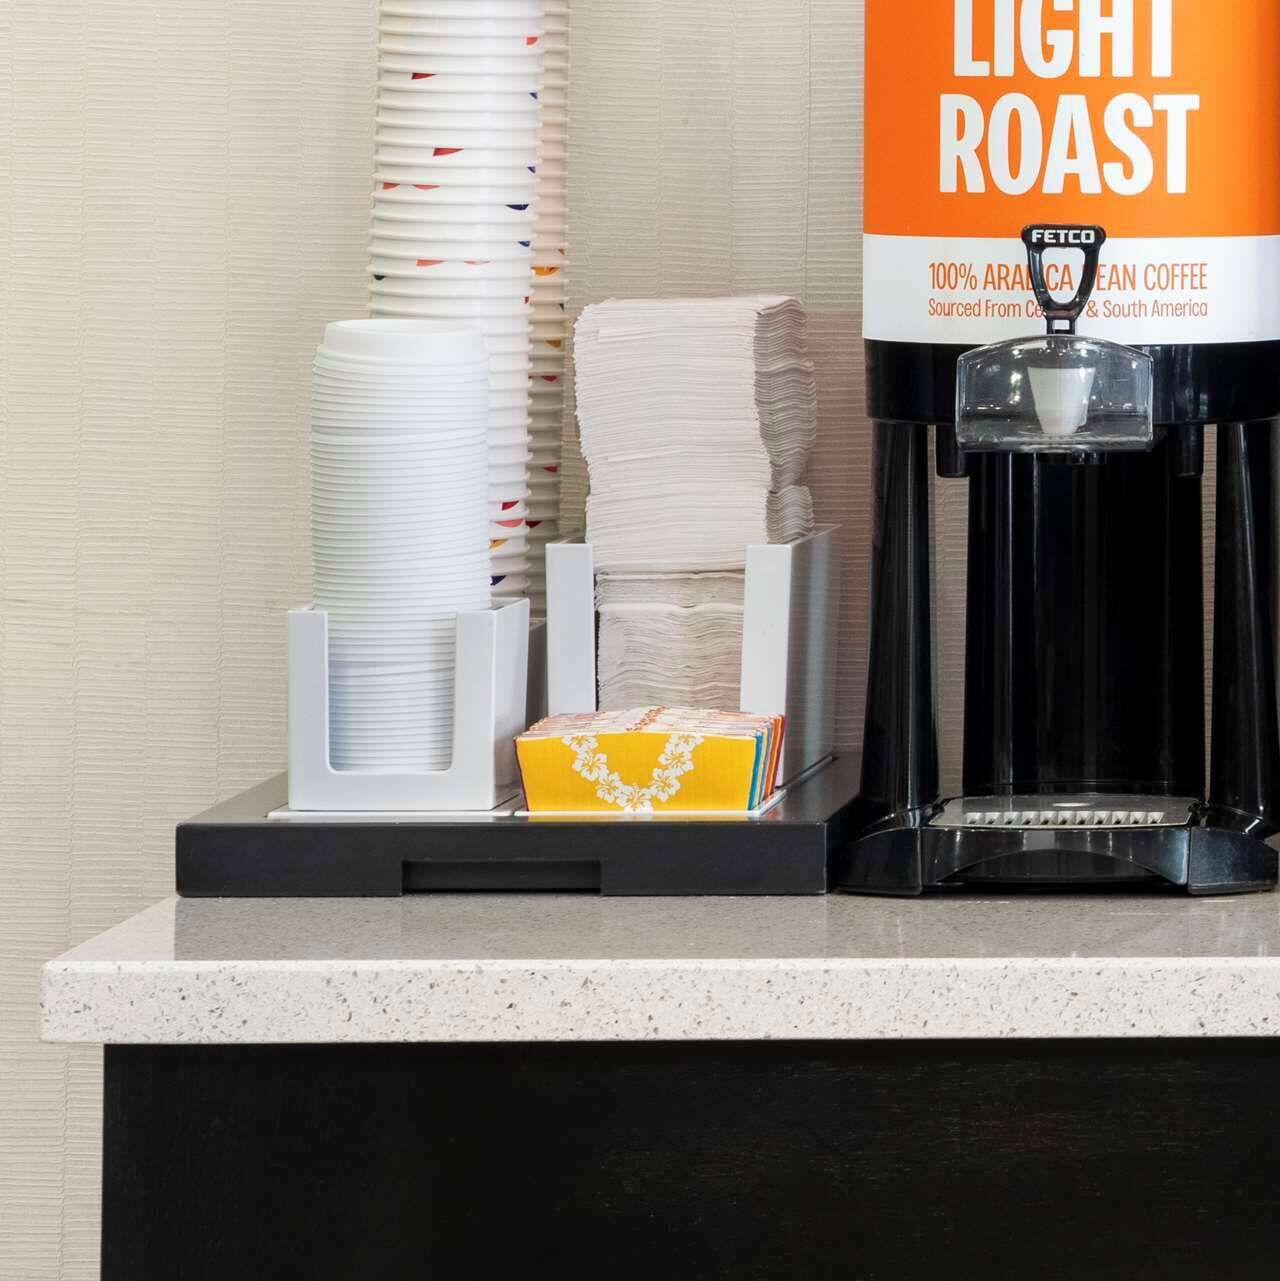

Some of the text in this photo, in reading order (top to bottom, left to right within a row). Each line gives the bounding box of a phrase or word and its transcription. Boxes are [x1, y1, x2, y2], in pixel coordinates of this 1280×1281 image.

[939, 92, 1200, 195] ROAST
[1031, 229, 1096, 244] FETCO
[928, 262, 1208, 291] 100% ARACA EAN COFFEE
[928, 298, 981, 318] Sourced
[985, 300, 1022, 318] From
[1086, 299, 1099, 319] &
[1103, 299, 1147, 319] South
[1151, 298, 1208, 318] America
